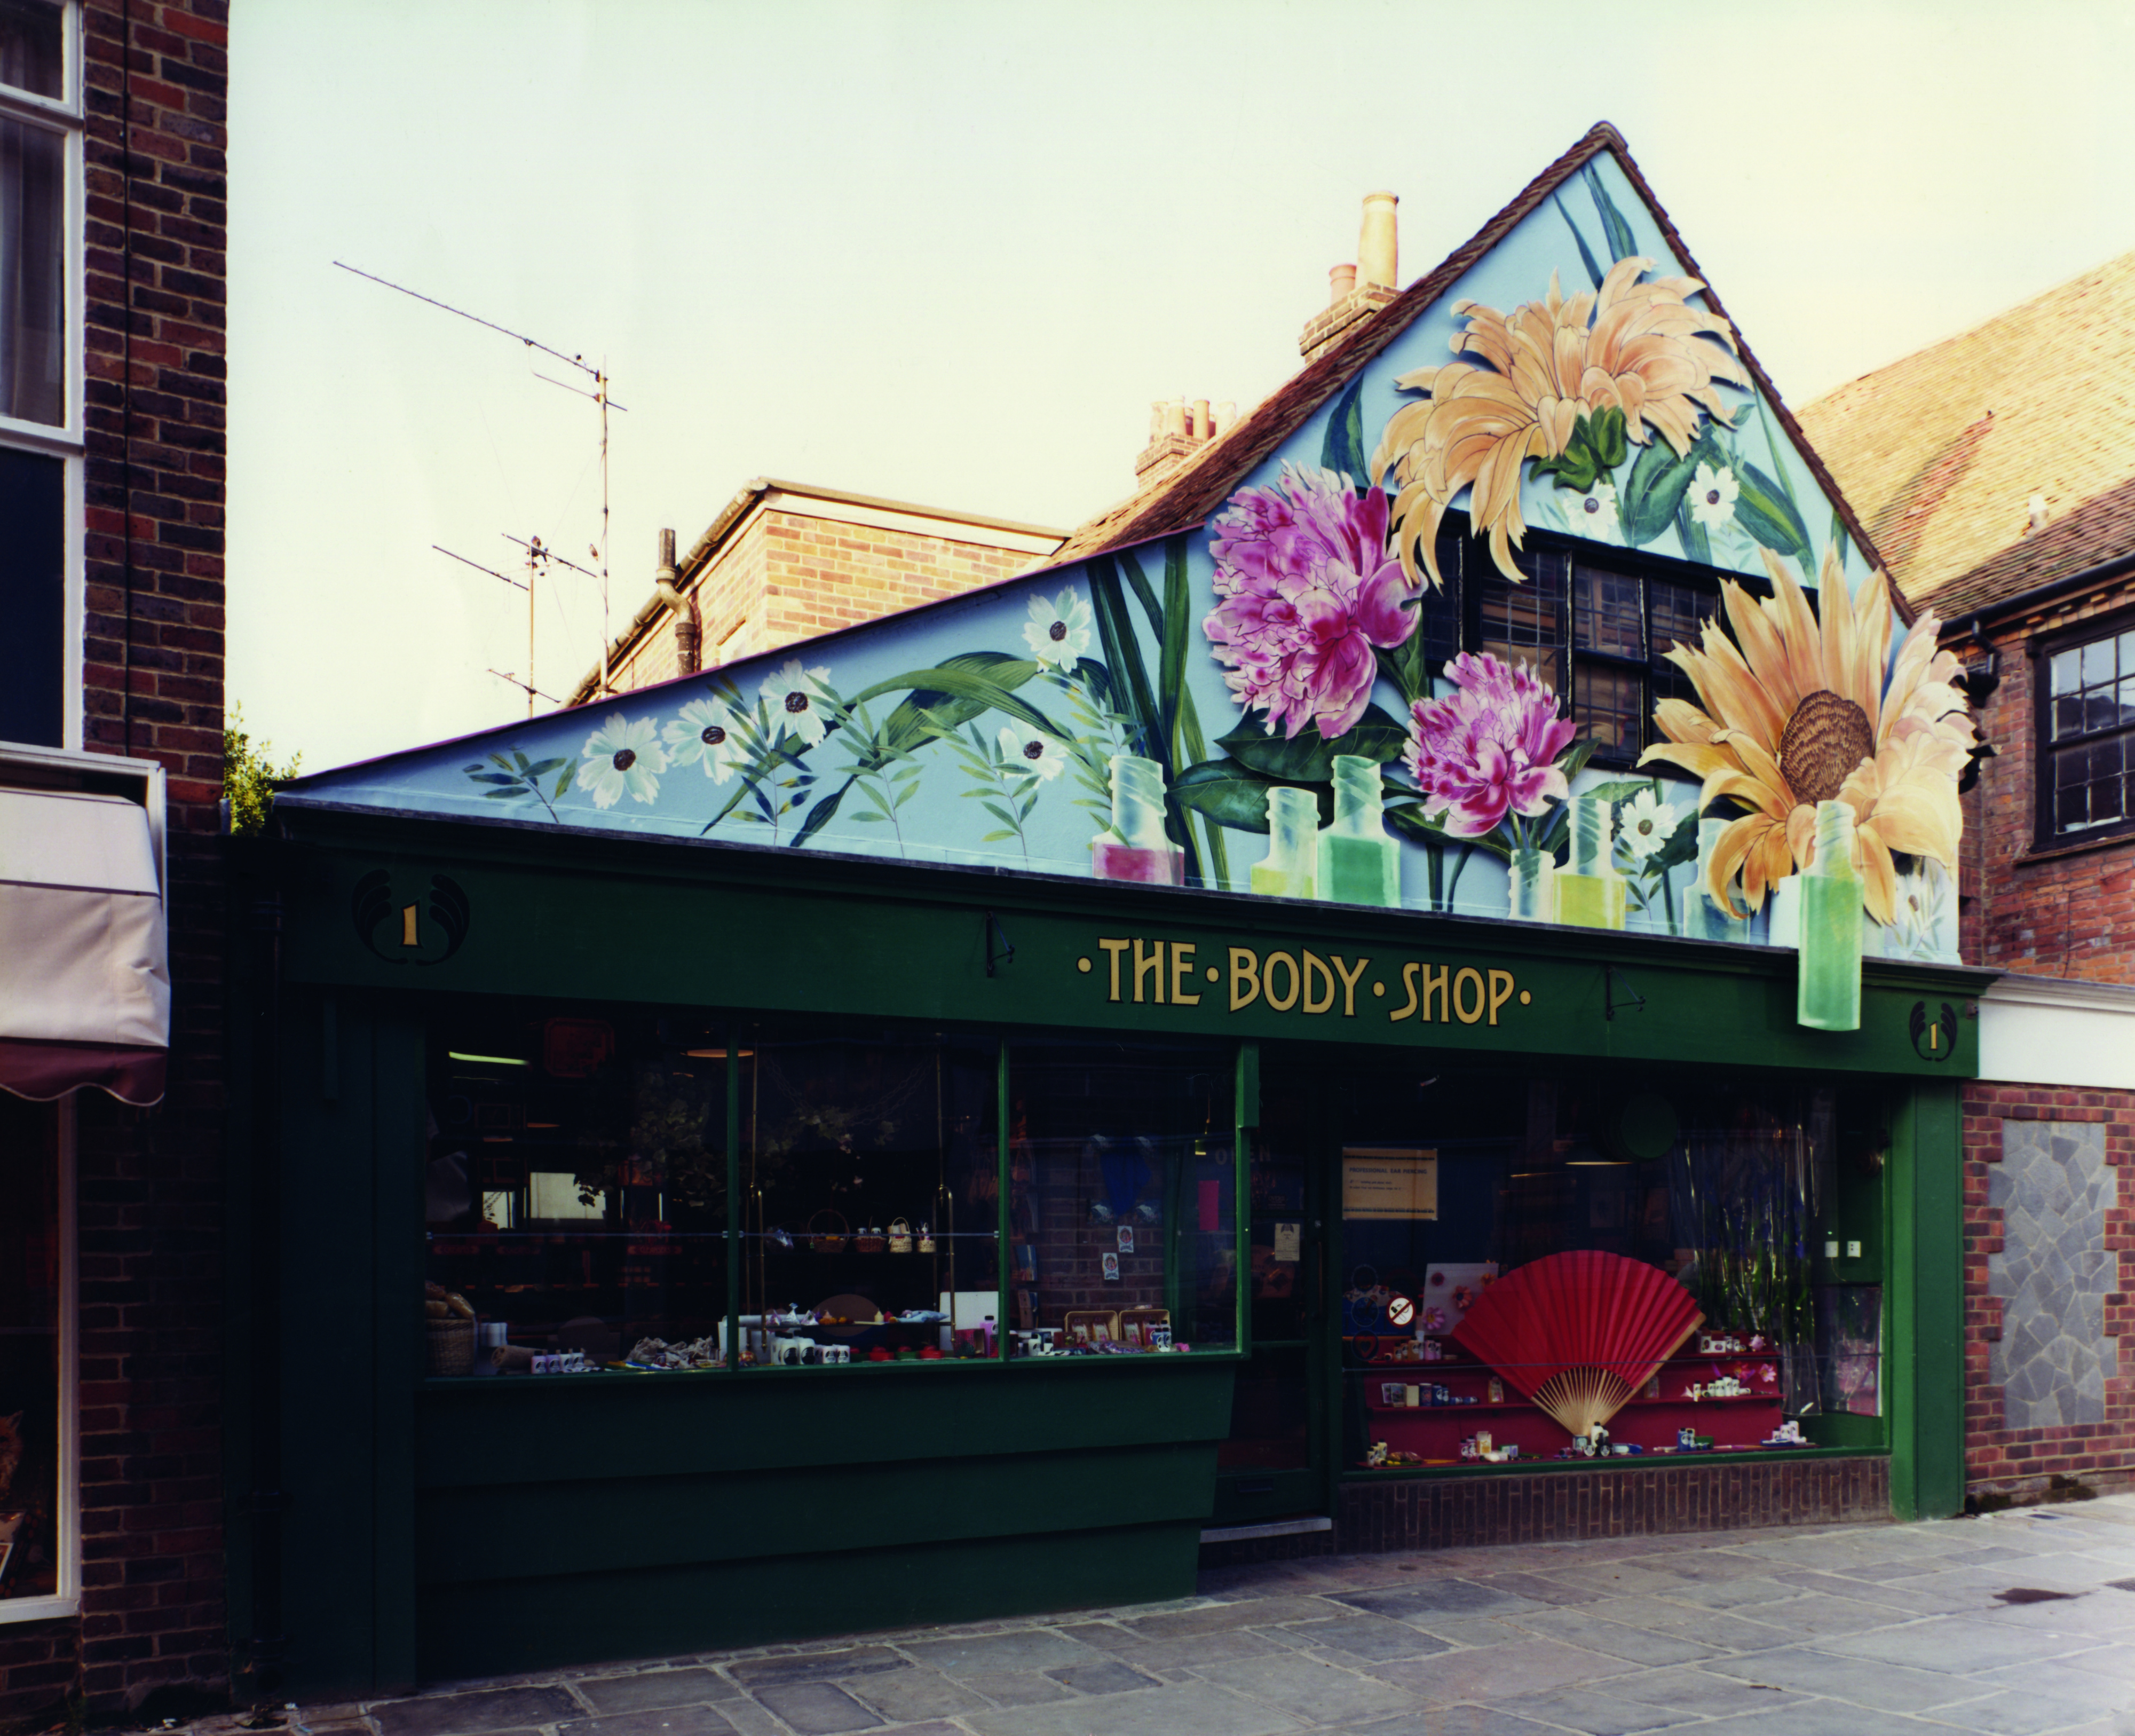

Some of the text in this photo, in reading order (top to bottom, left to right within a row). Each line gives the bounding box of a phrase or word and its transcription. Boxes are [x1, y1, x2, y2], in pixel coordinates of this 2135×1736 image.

[401, 901, 420, 947] 1
[1097, 937, 1516, 1026] THE BODY SHOP
[1930, 1021, 1938, 1050] 1
